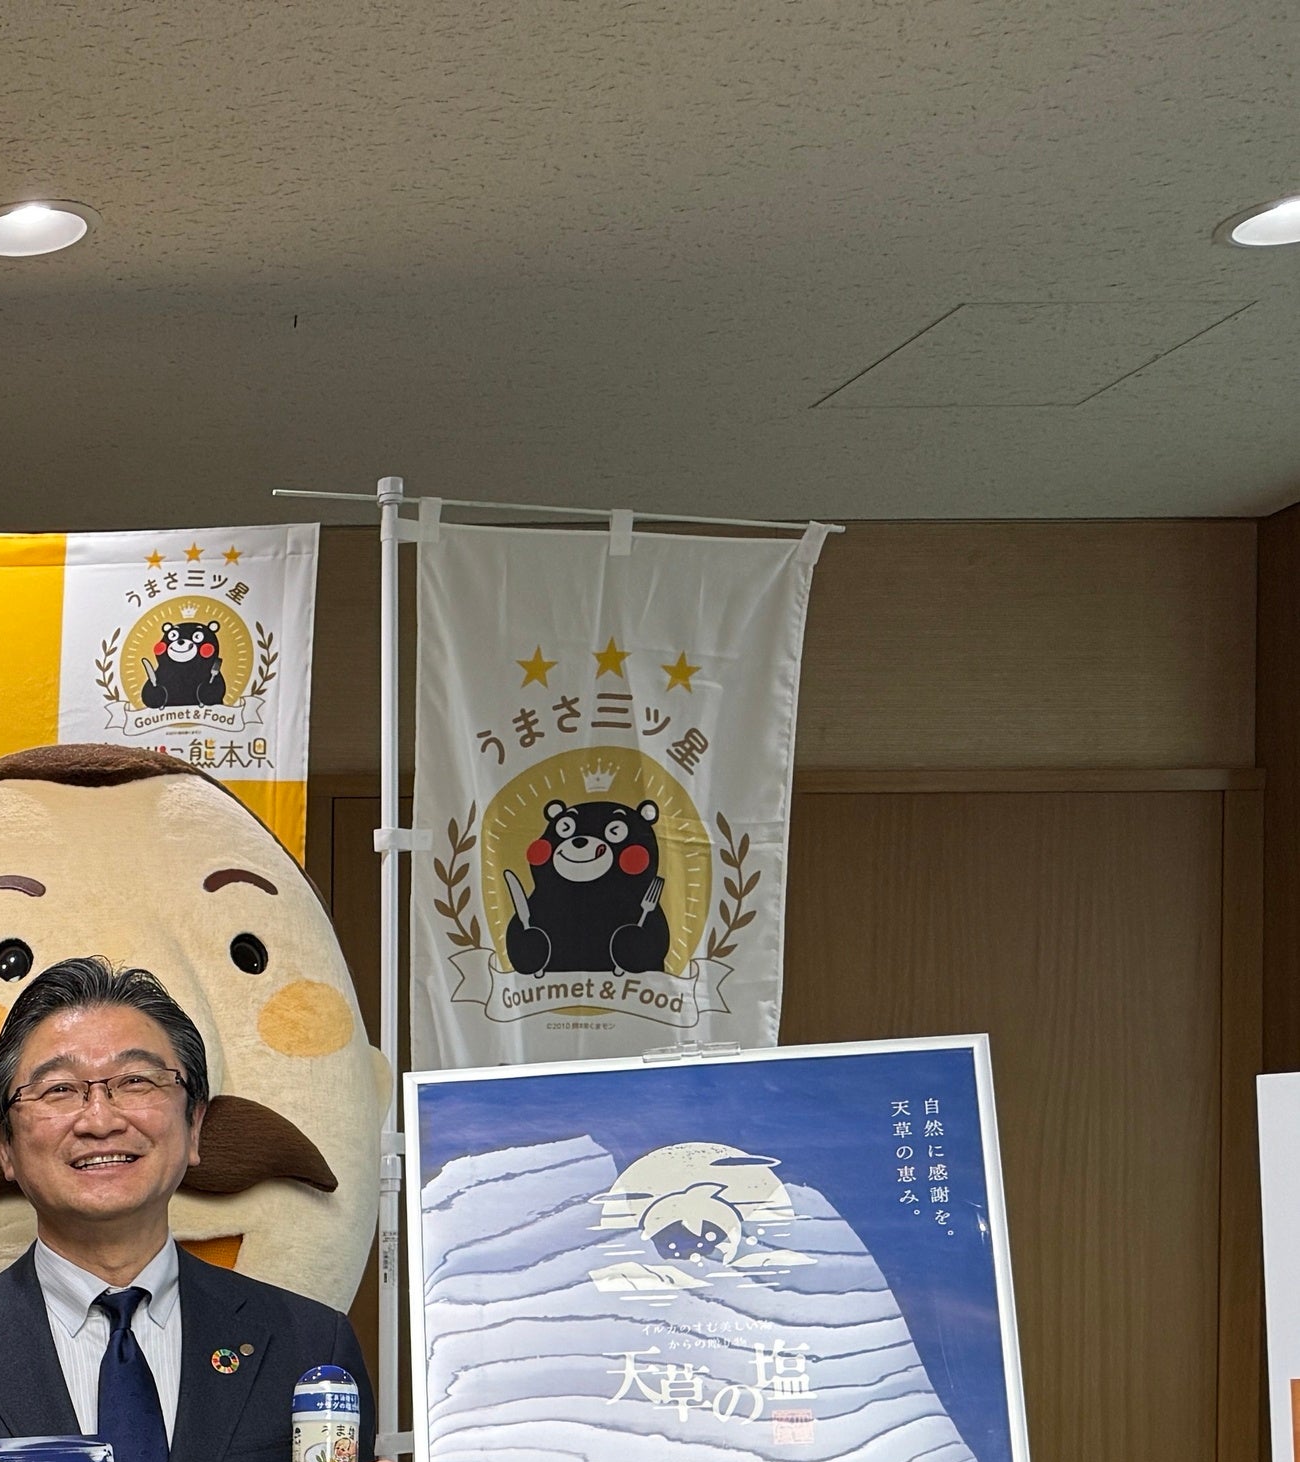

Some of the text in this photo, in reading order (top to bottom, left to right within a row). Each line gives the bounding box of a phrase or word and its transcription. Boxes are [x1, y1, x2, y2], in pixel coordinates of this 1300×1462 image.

[126, 570, 250, 608] うまさ三ツ星
[134, 708, 236, 729] Gourmet & Food
[476, 692, 709, 776] うまさ三ツ星
[502, 979, 684, 1014] Gourmet & Food
[890, 1100, 920, 1215] 天草の恵み。
[924, 1097, 954, 1236] 自然に感謝を。
[602, 1339, 818, 1425] 天草の塩
